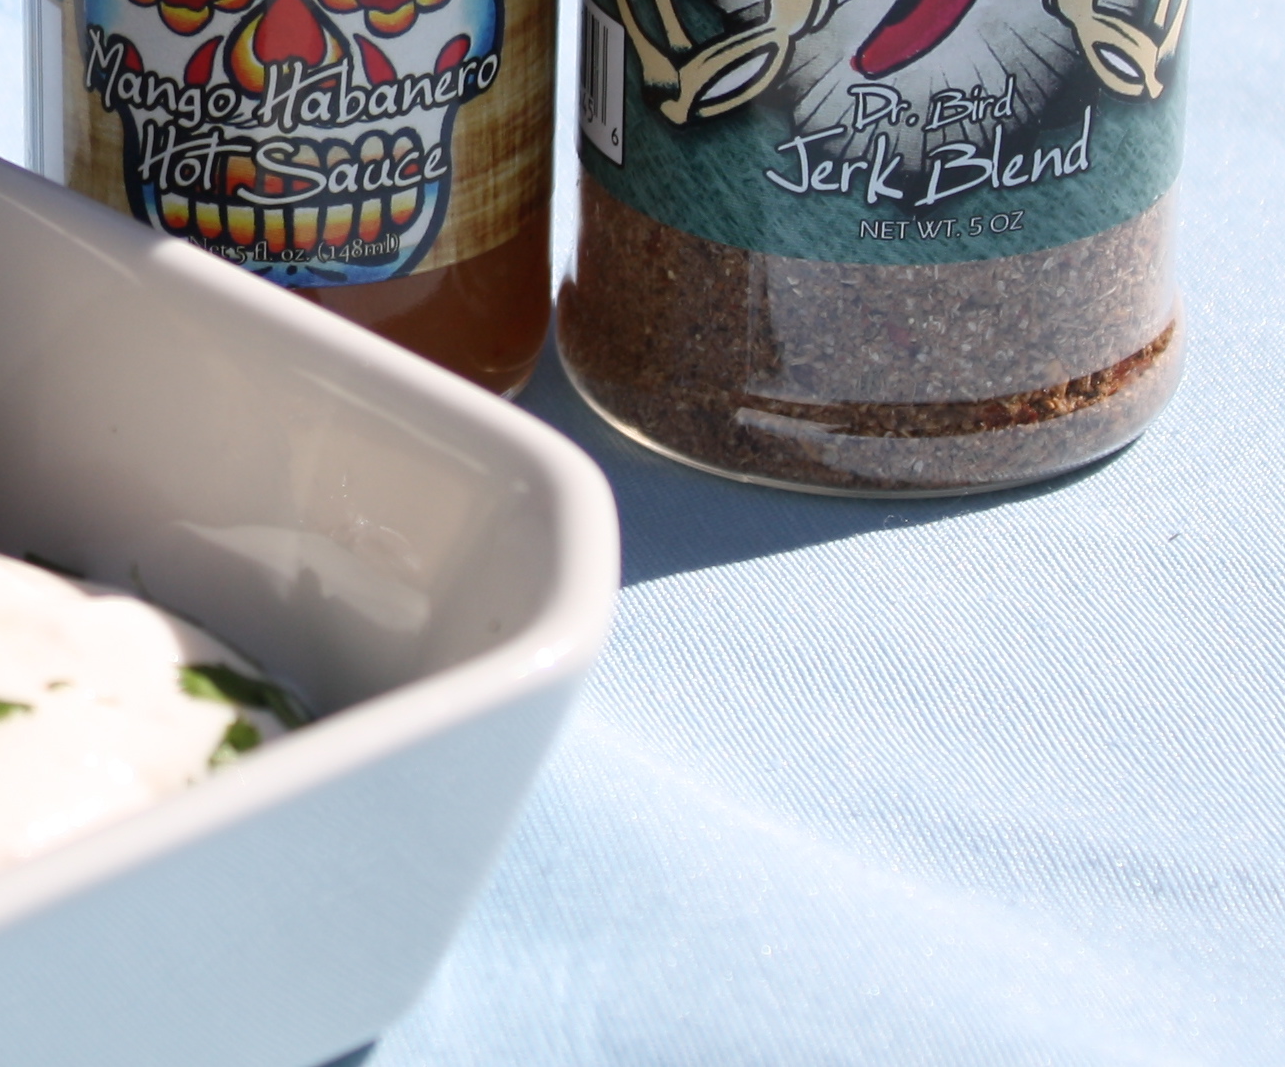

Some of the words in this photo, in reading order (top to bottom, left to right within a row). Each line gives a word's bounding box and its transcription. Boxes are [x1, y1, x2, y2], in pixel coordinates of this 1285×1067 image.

[86, 28, 236, 128] Mango
[257, 53, 499, 129] Habanero
[849, 85, 918, 130] Dr.
[924, 77, 1015, 131] Bird
[139, 124, 251, 191] Hot
[237, 141, 449, 205] Sauce
[766, 126, 904, 204] Jerk
[914, 104, 1092, 207] Blend
[235, 245, 247, 264] 5
[281, 249, 310, 262] oz.
[859, 219, 910, 240] NET
[916, 218, 961, 239] WT.
[969, 216, 984, 236] 5
[989, 210, 1024, 233] OZ
